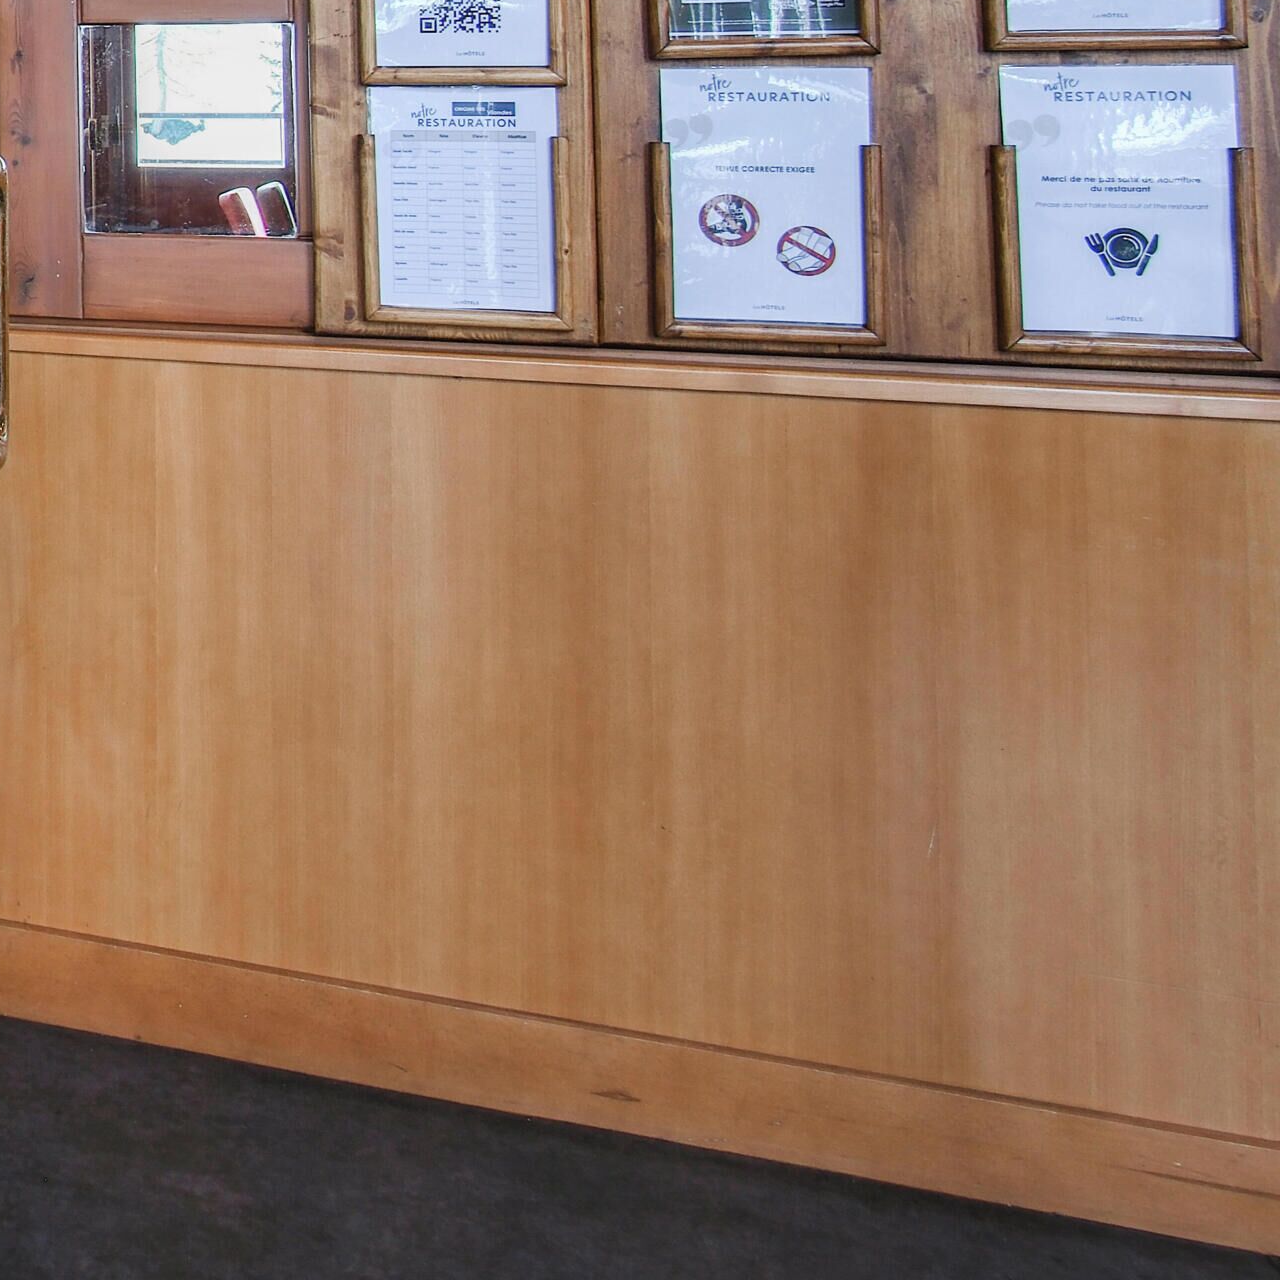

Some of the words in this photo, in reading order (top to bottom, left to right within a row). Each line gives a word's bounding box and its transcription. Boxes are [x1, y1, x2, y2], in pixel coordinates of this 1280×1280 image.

[700, 74, 732, 93] notre
[1044, 72, 1079, 93] notre
[707, 91, 831, 103] RESTAURATION
[1053, 90, 1192, 102] RESTAURATION
[411, 103, 437, 120] notre
[417, 118, 517, 128] RESTAURATION
[741, 165, 784, 173] CORRECTE
[1041, 175, 1067, 183] Merci
[1104, 185, 1151, 193] restaurant
[1089, 201, 1106, 209] take
[1153, 202, 1166, 210] the
[1167, 203, 1209, 211] restaurant
